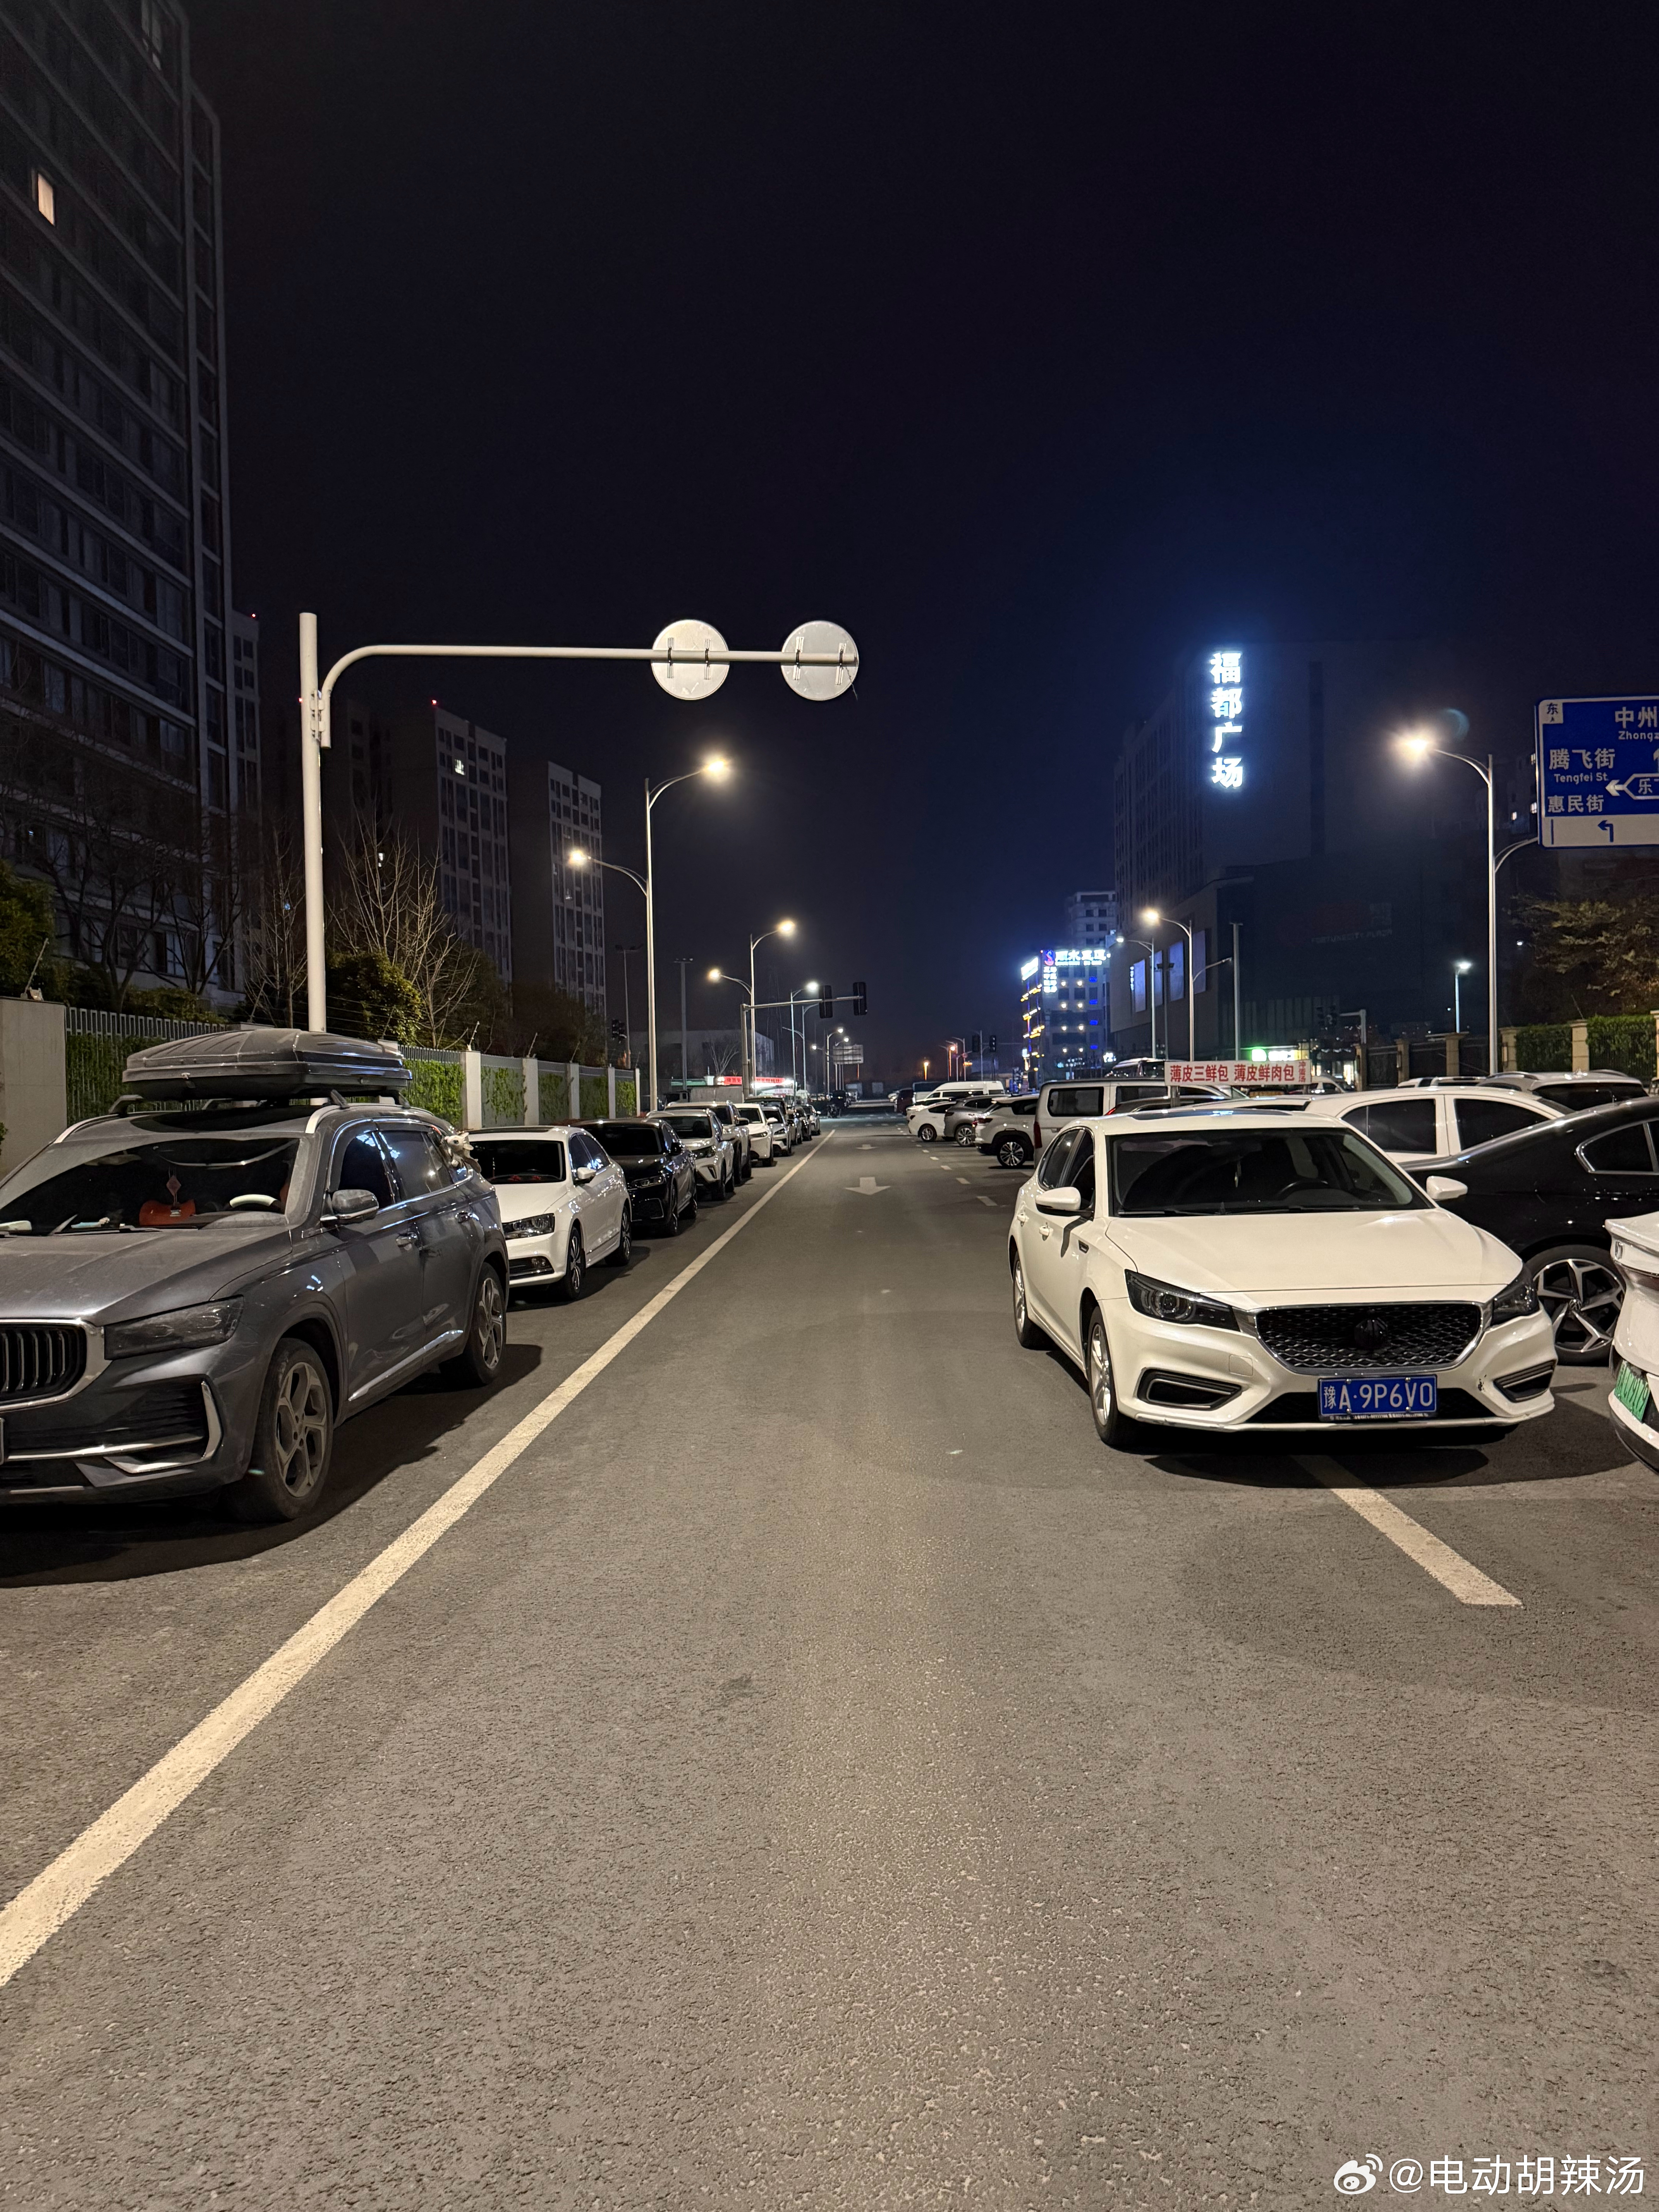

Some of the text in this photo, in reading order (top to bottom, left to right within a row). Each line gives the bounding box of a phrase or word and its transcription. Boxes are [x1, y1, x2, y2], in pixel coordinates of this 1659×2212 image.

[1546, 702, 1558, 714] 东
[1615, 706, 1657, 728] 中州
[1210, 652, 1243, 788] 福都广场
[1549, 748, 1615, 770] 腾飞街
[1554, 772, 1609, 785] Tengfei St
[1547, 794, 1604, 812] 惠民街
[1170, 1064, 1295, 1082] 薄皮三鲜包 薄皮鲜肉包
